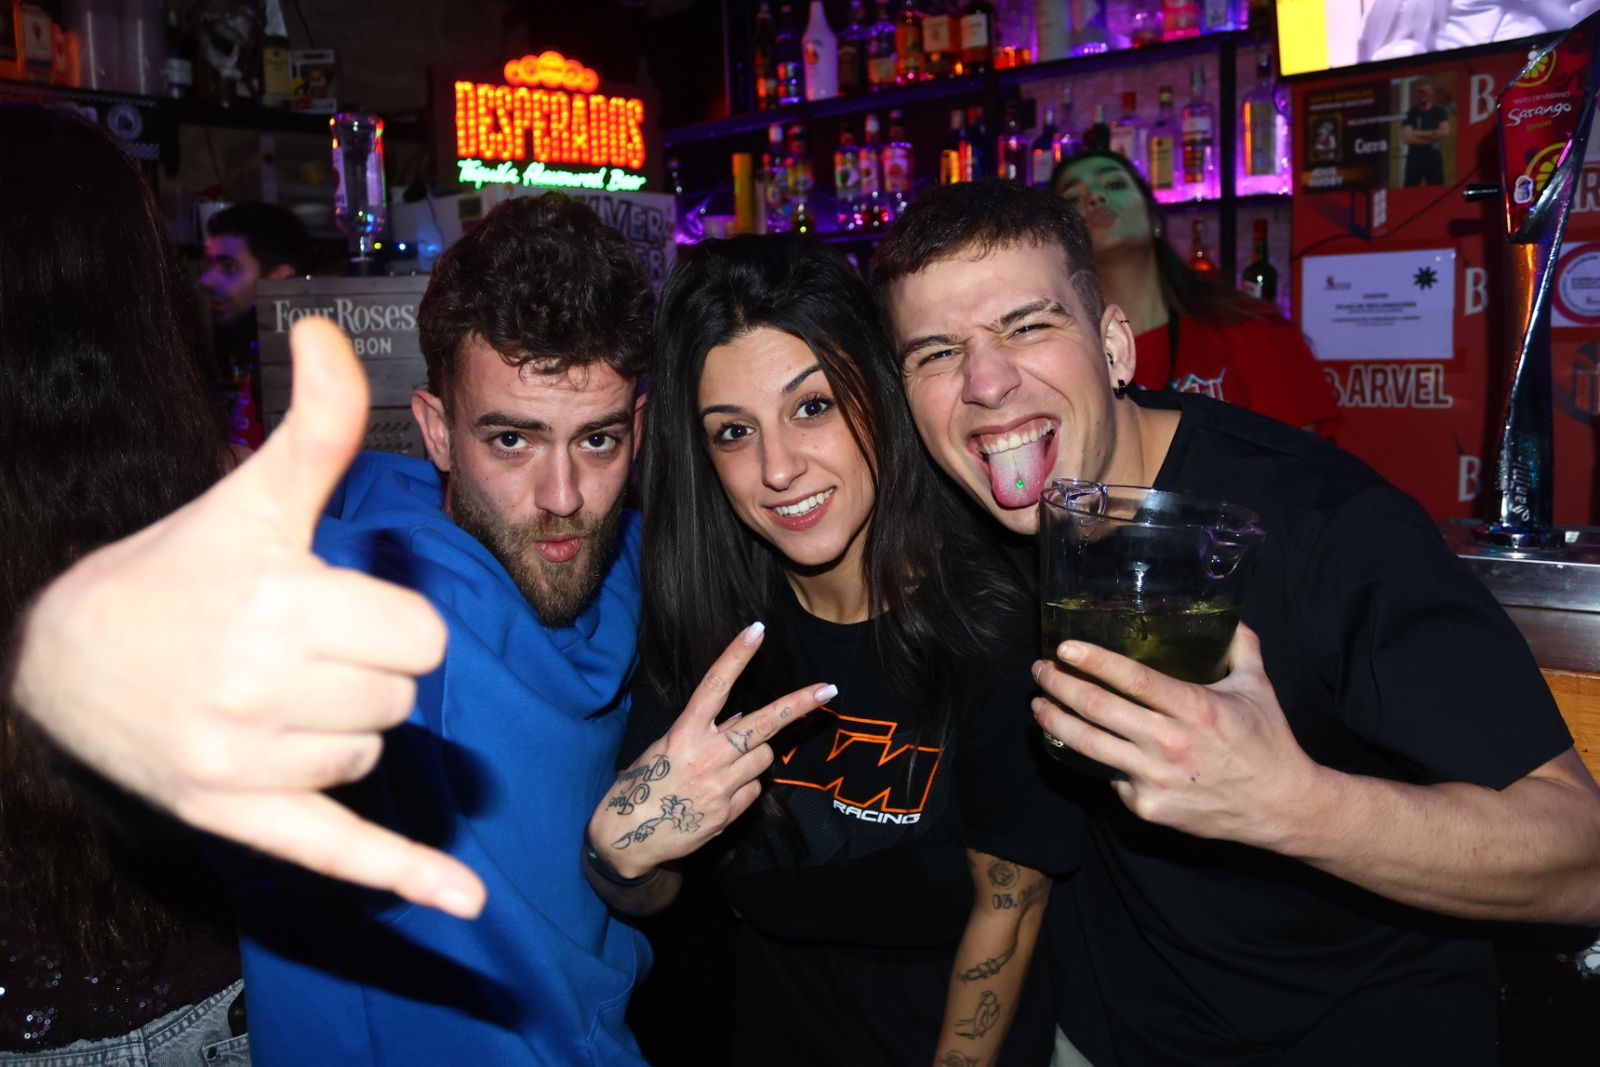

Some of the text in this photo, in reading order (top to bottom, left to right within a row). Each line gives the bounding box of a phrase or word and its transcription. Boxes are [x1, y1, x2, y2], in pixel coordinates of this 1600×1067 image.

[455, 81, 645, 169] DESPERADOS
[1506, 102, 1571, 127] Sarango
[457, 158, 520, 189] Tequila
[335, 298, 416, 334] Roses
[354, 337, 392, 355] BON
[832, 798, 922, 825] RACING
